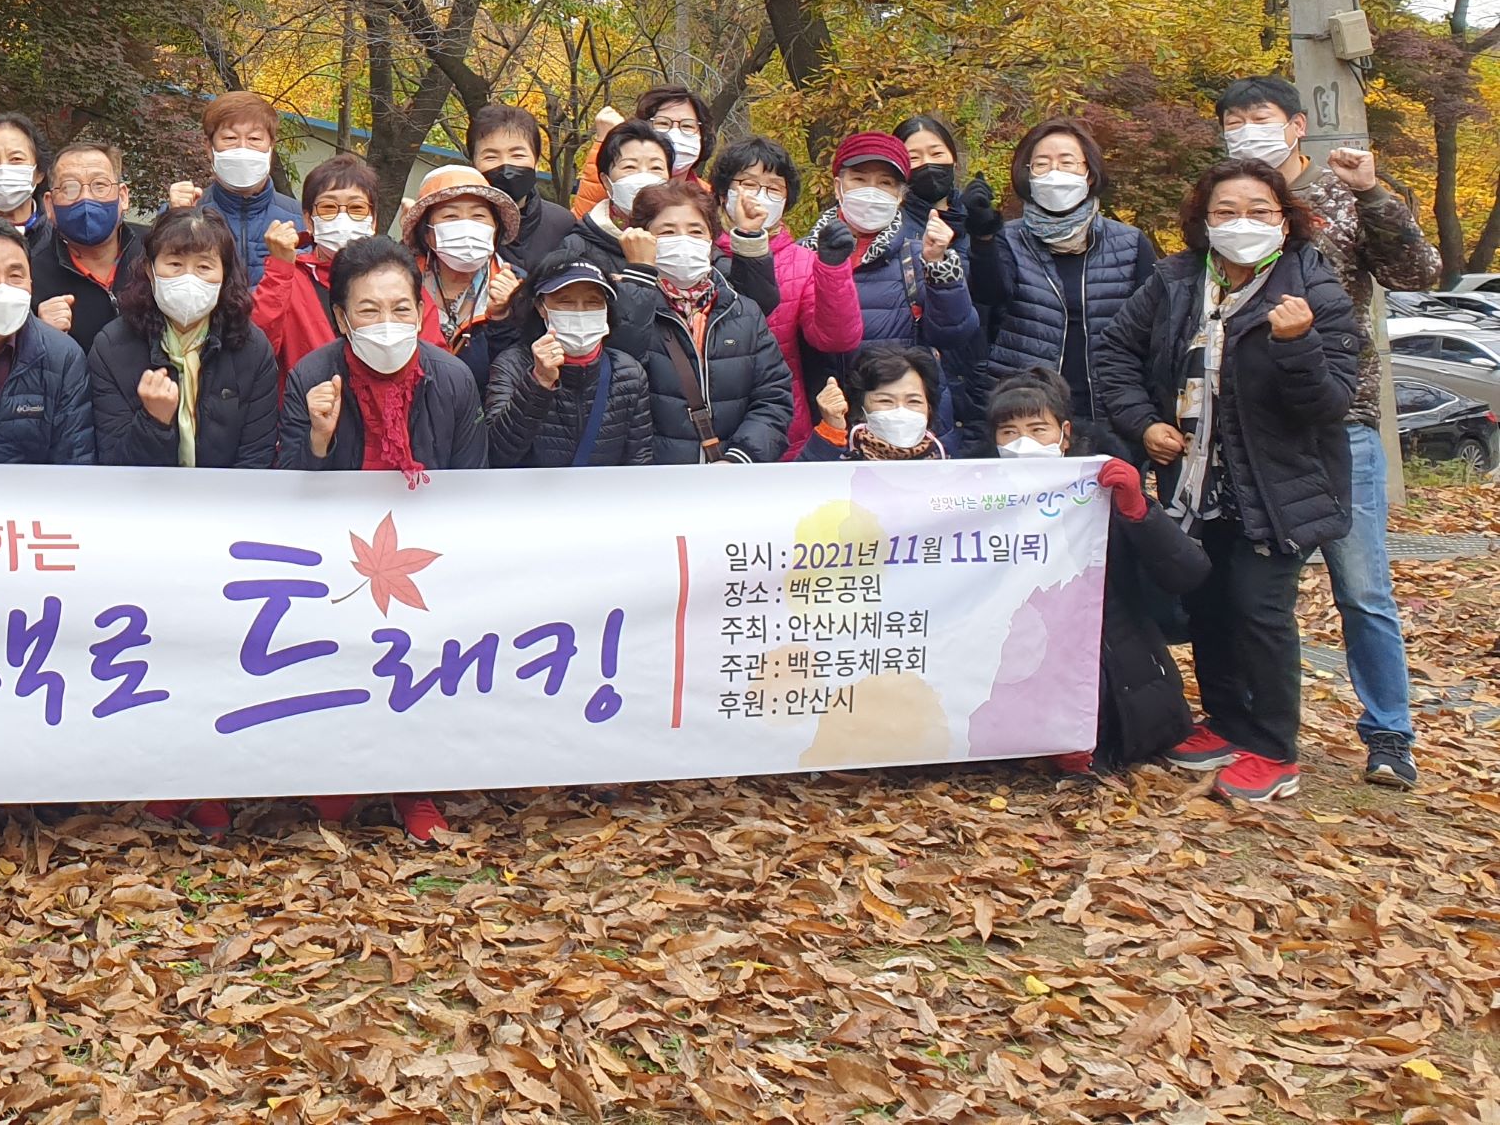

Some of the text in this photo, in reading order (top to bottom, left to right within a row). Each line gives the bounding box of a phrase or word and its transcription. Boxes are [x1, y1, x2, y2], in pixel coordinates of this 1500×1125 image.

[931, 496, 977, 511] 살맛나는
[980, 493, 1031, 511] 생생도시
[725, 542, 772, 572] 일시
[792, 538, 879, 571] 2021년
[883, 534, 943, 565] 11월
[950, 530, 1049, 565] 11일(목)
[723, 580, 769, 608] 장소
[789, 574, 882, 605] 백운공원
[214, 541, 624, 734] 트래킹
[720, 615, 768, 644] 주최
[788, 610, 929, 643] 안산시체육회
[719, 652, 768, 683] 주관
[787, 646, 927, 678] 백운동체육회
[717, 689, 765, 720] 후원
[785, 684, 855, 716] 안산시
